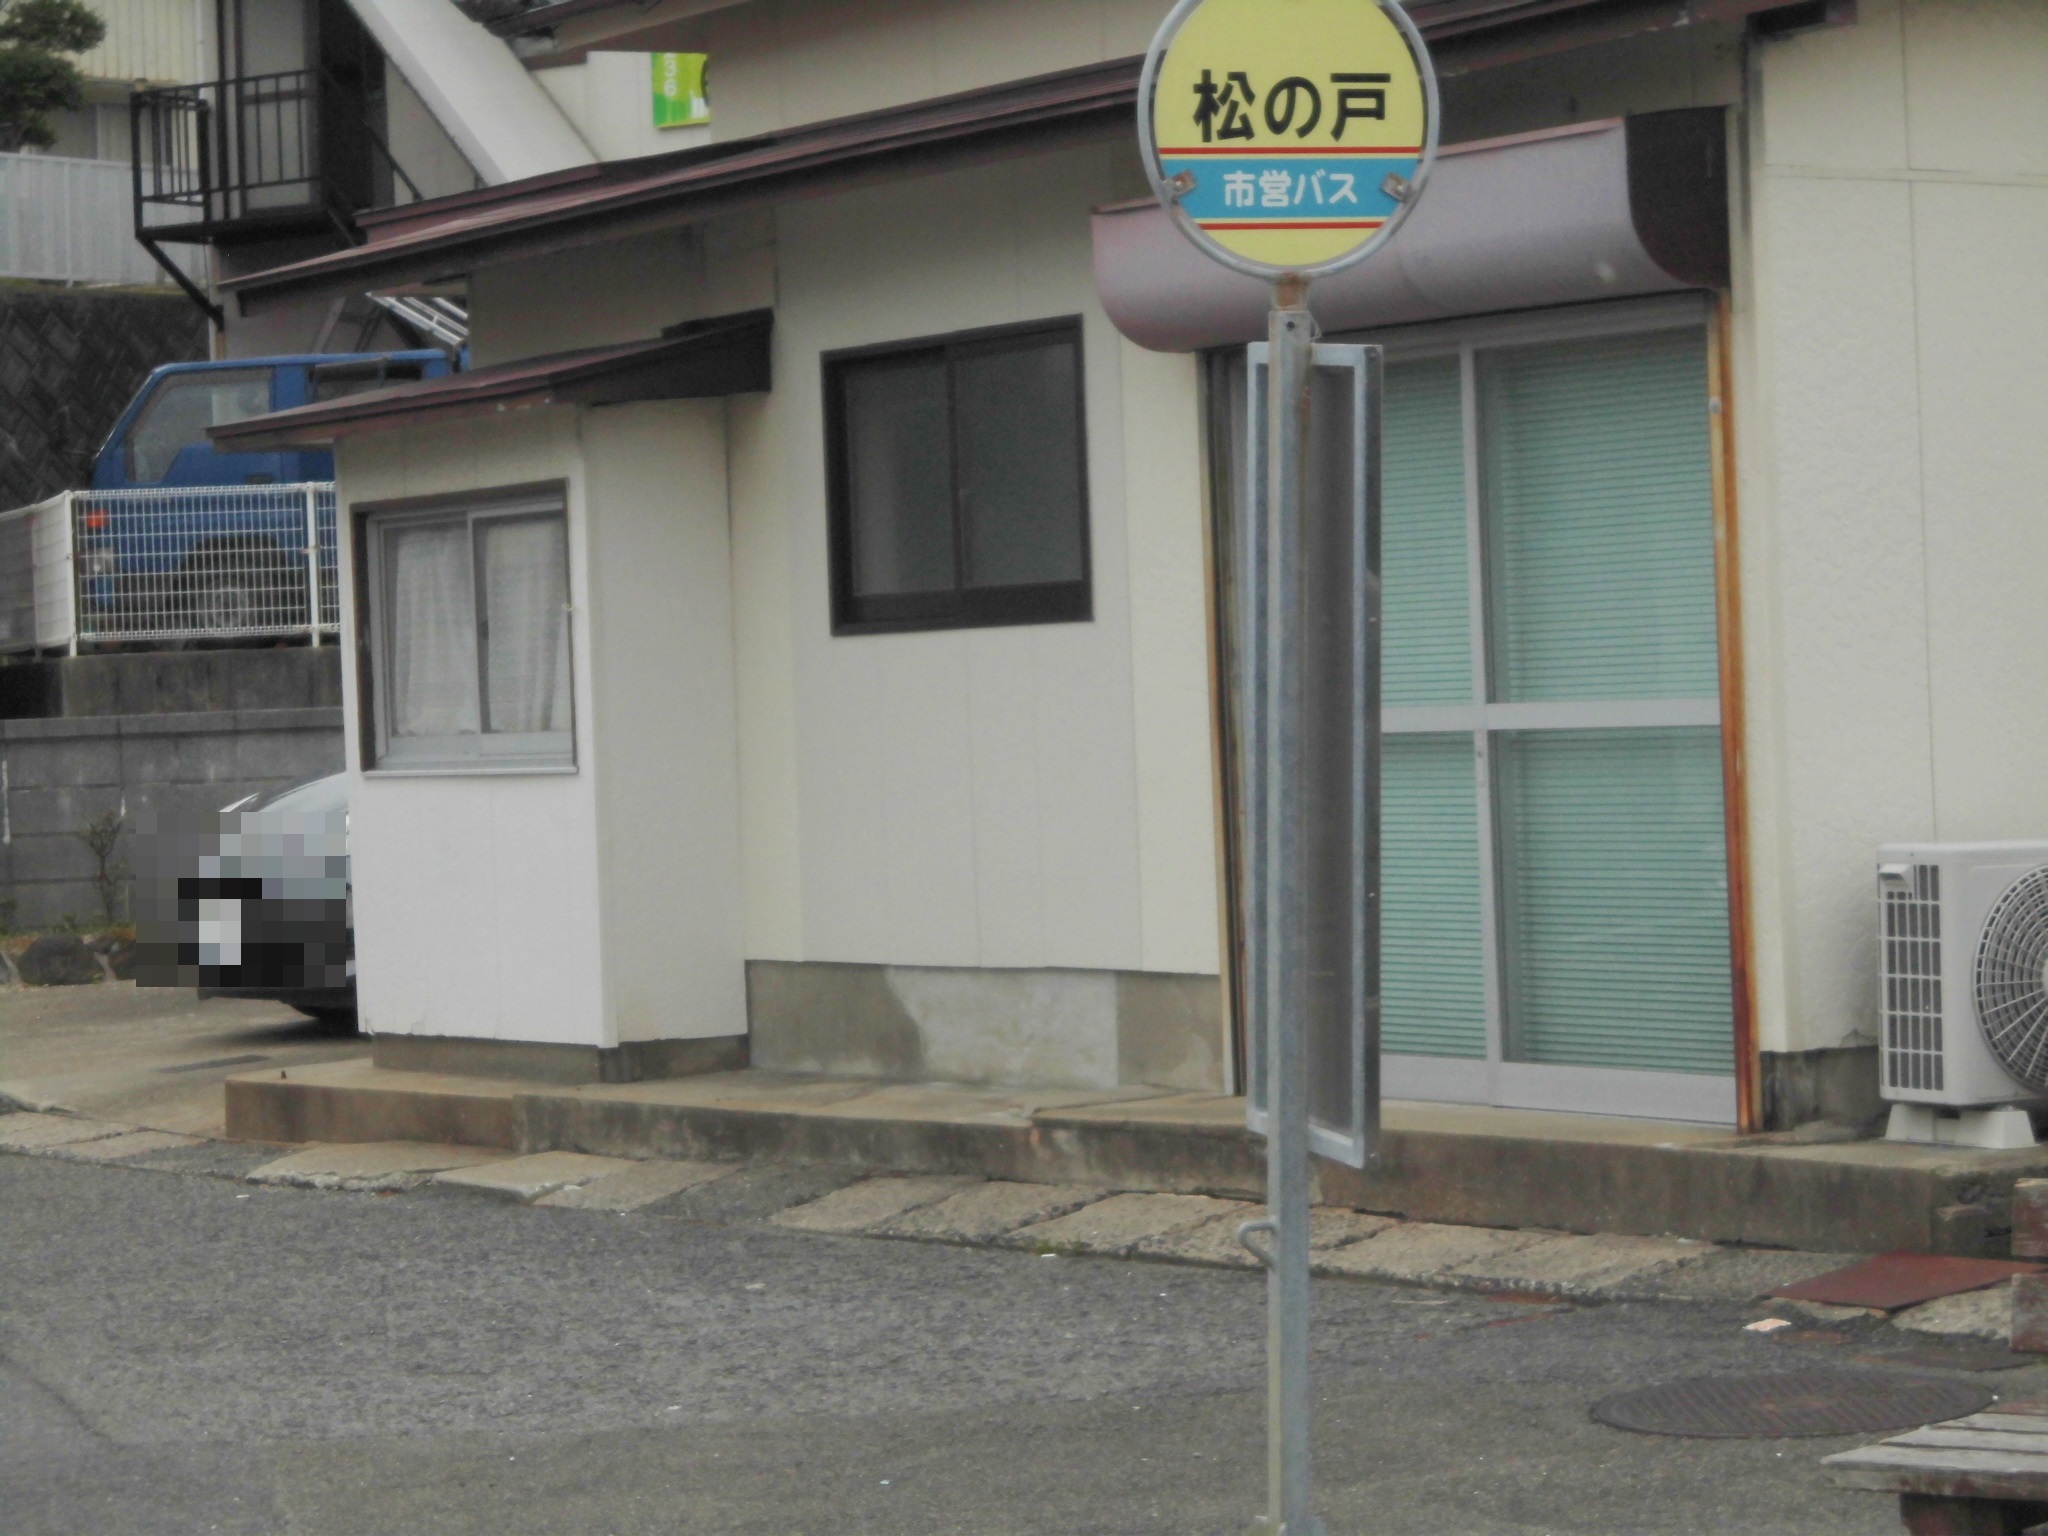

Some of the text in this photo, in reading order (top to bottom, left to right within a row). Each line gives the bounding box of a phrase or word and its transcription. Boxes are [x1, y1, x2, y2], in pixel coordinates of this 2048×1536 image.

[1193, 69, 1391, 142] 松の戸
[1223, 169, 1357, 207] 市営バス
